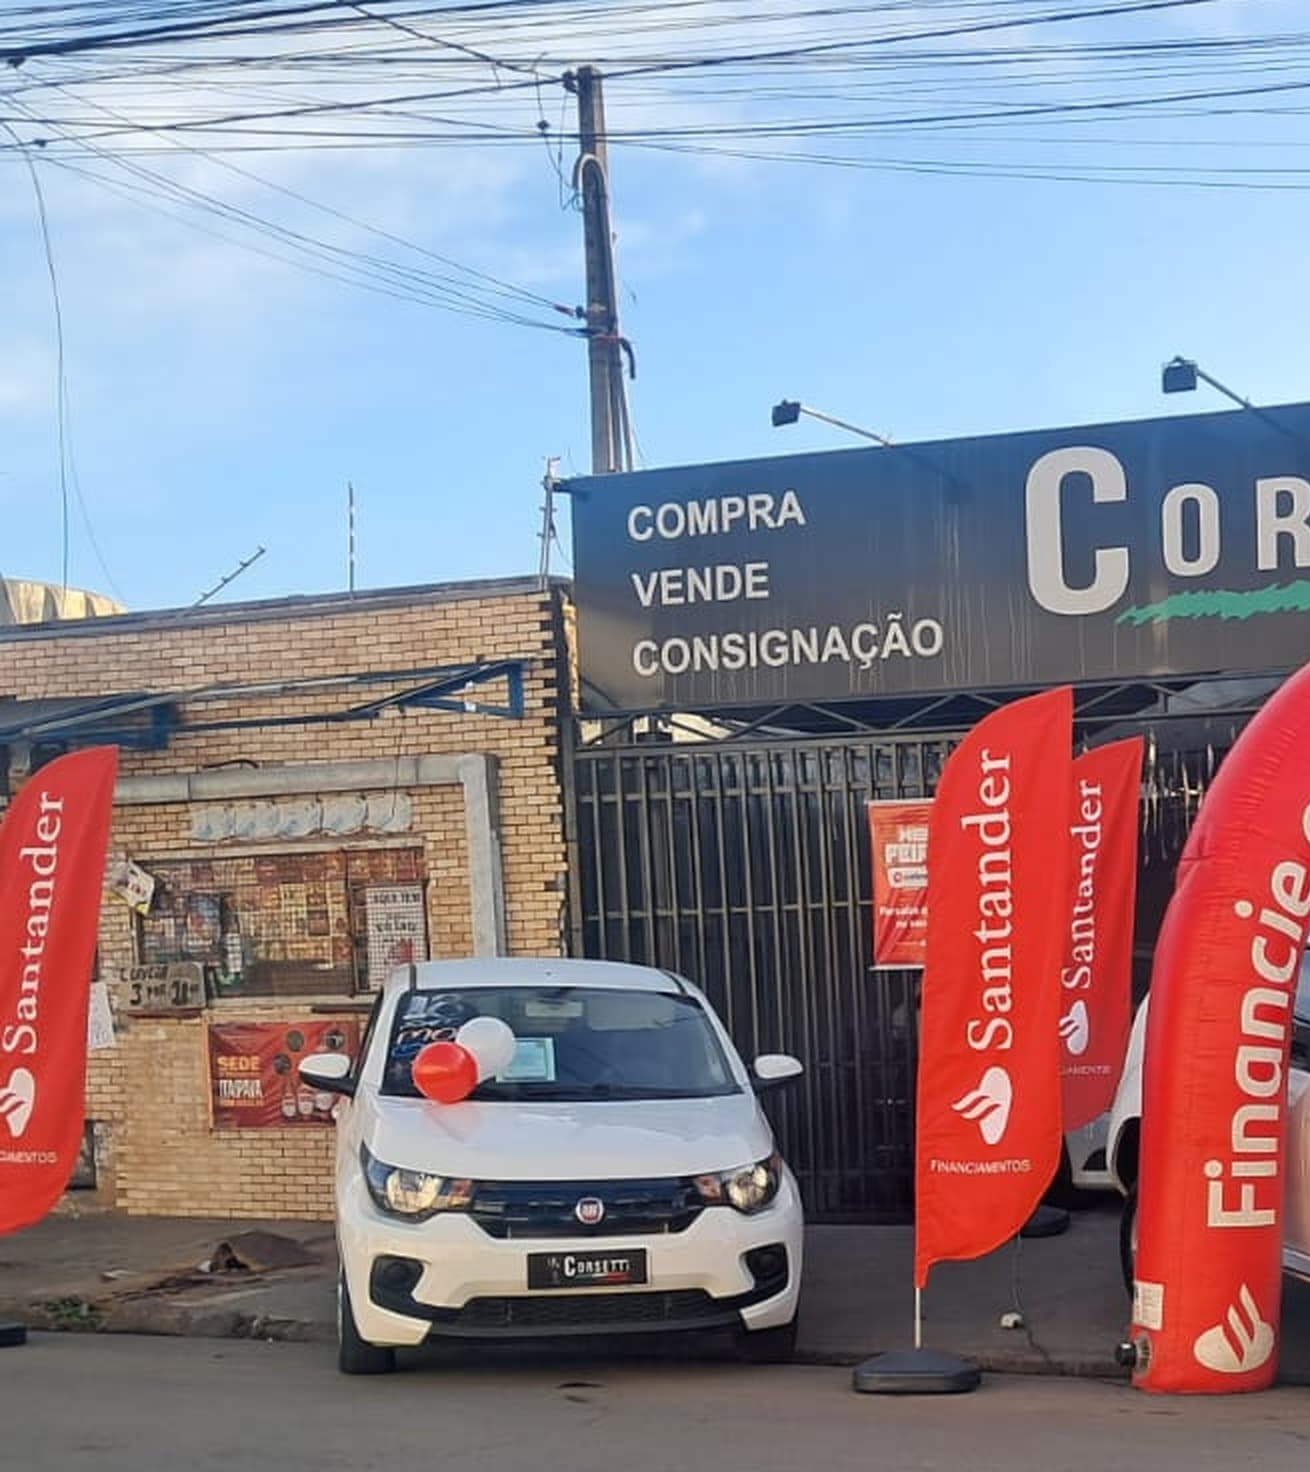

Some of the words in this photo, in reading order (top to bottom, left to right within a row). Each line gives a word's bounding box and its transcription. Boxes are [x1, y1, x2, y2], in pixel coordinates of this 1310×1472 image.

[627, 490, 807, 541] COMPRA
[631, 561, 770, 608] VENDE
[632, 611, 944, 677] CONSIGNAÇÃO
[960, 749, 1013, 1050] Santander
[1060, 779, 1102, 990] Santander
[2, 791, 64, 1055] Santander
[930, 1159, 1031, 1175] FINANCIAMENTOS
[563, 1255, 631, 1278] CORSETTI
